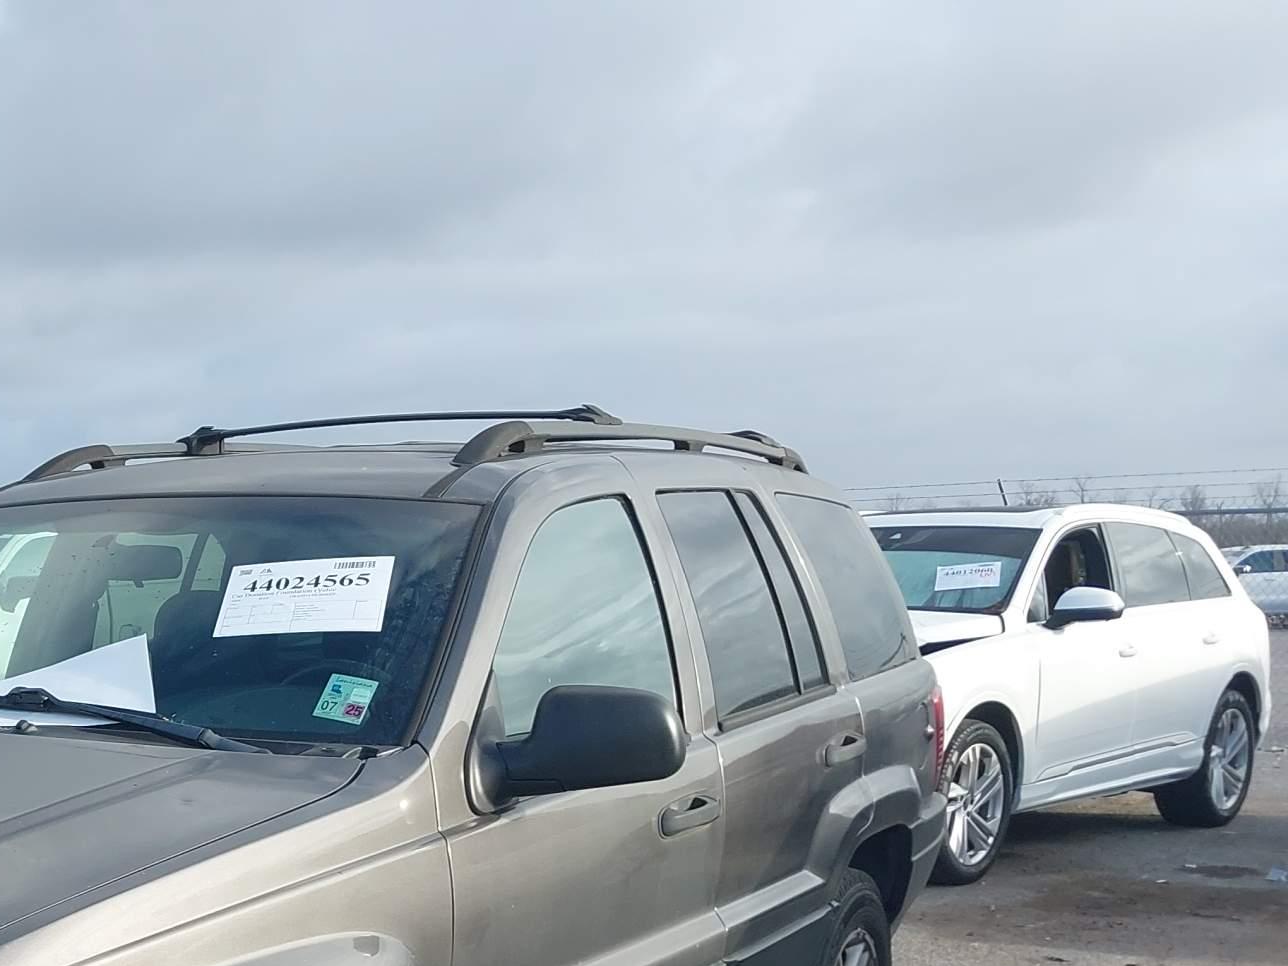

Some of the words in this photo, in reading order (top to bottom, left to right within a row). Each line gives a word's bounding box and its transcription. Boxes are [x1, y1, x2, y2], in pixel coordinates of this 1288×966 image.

[243, 572, 371, 593] 44024565
[321, 700, 338, 712] 07
[345, 704, 363, 717] 25
